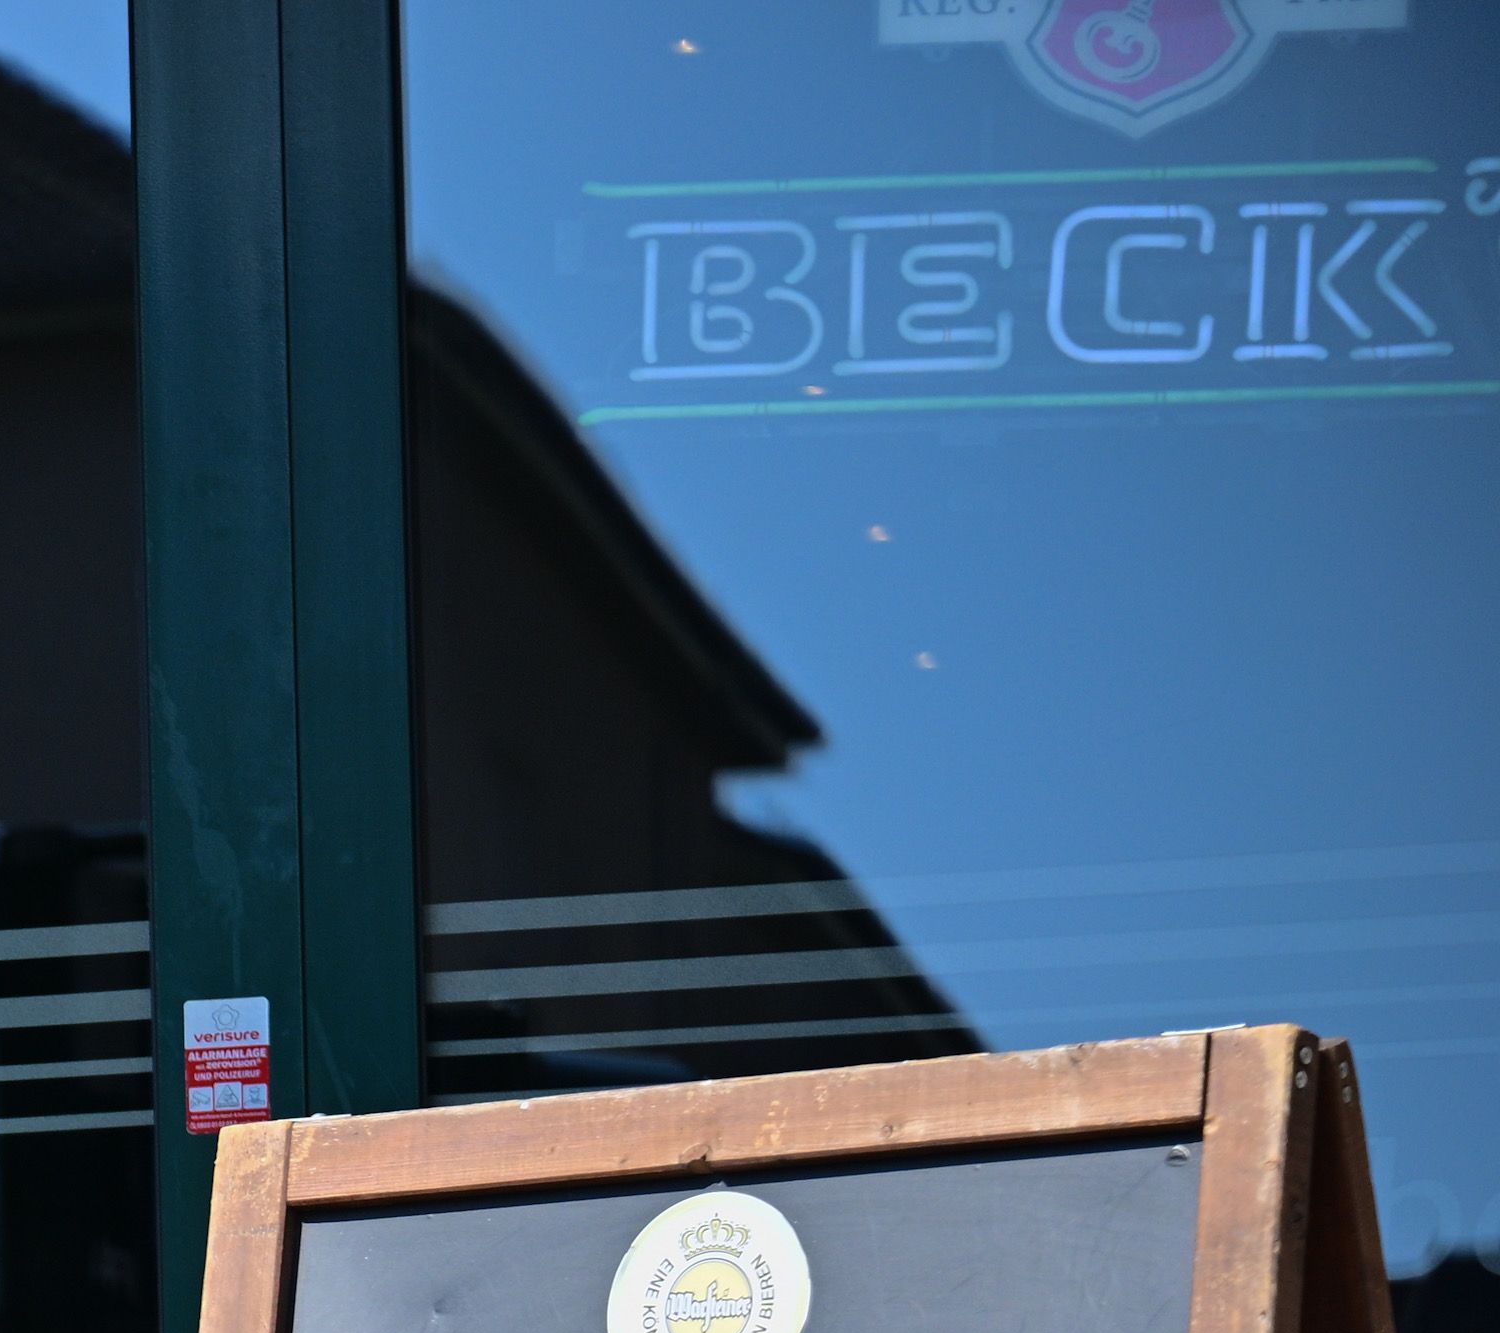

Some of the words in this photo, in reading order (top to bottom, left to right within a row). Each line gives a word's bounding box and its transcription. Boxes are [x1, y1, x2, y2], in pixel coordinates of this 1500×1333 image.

[193, 1030, 260, 1043] verisure
[188, 1047, 268, 1062] ALARMANLAGE
[194, 1071, 213, 1081] UND
[645, 1258, 675, 1299] EINE
[751, 1254, 775, 1320] BIEREN
